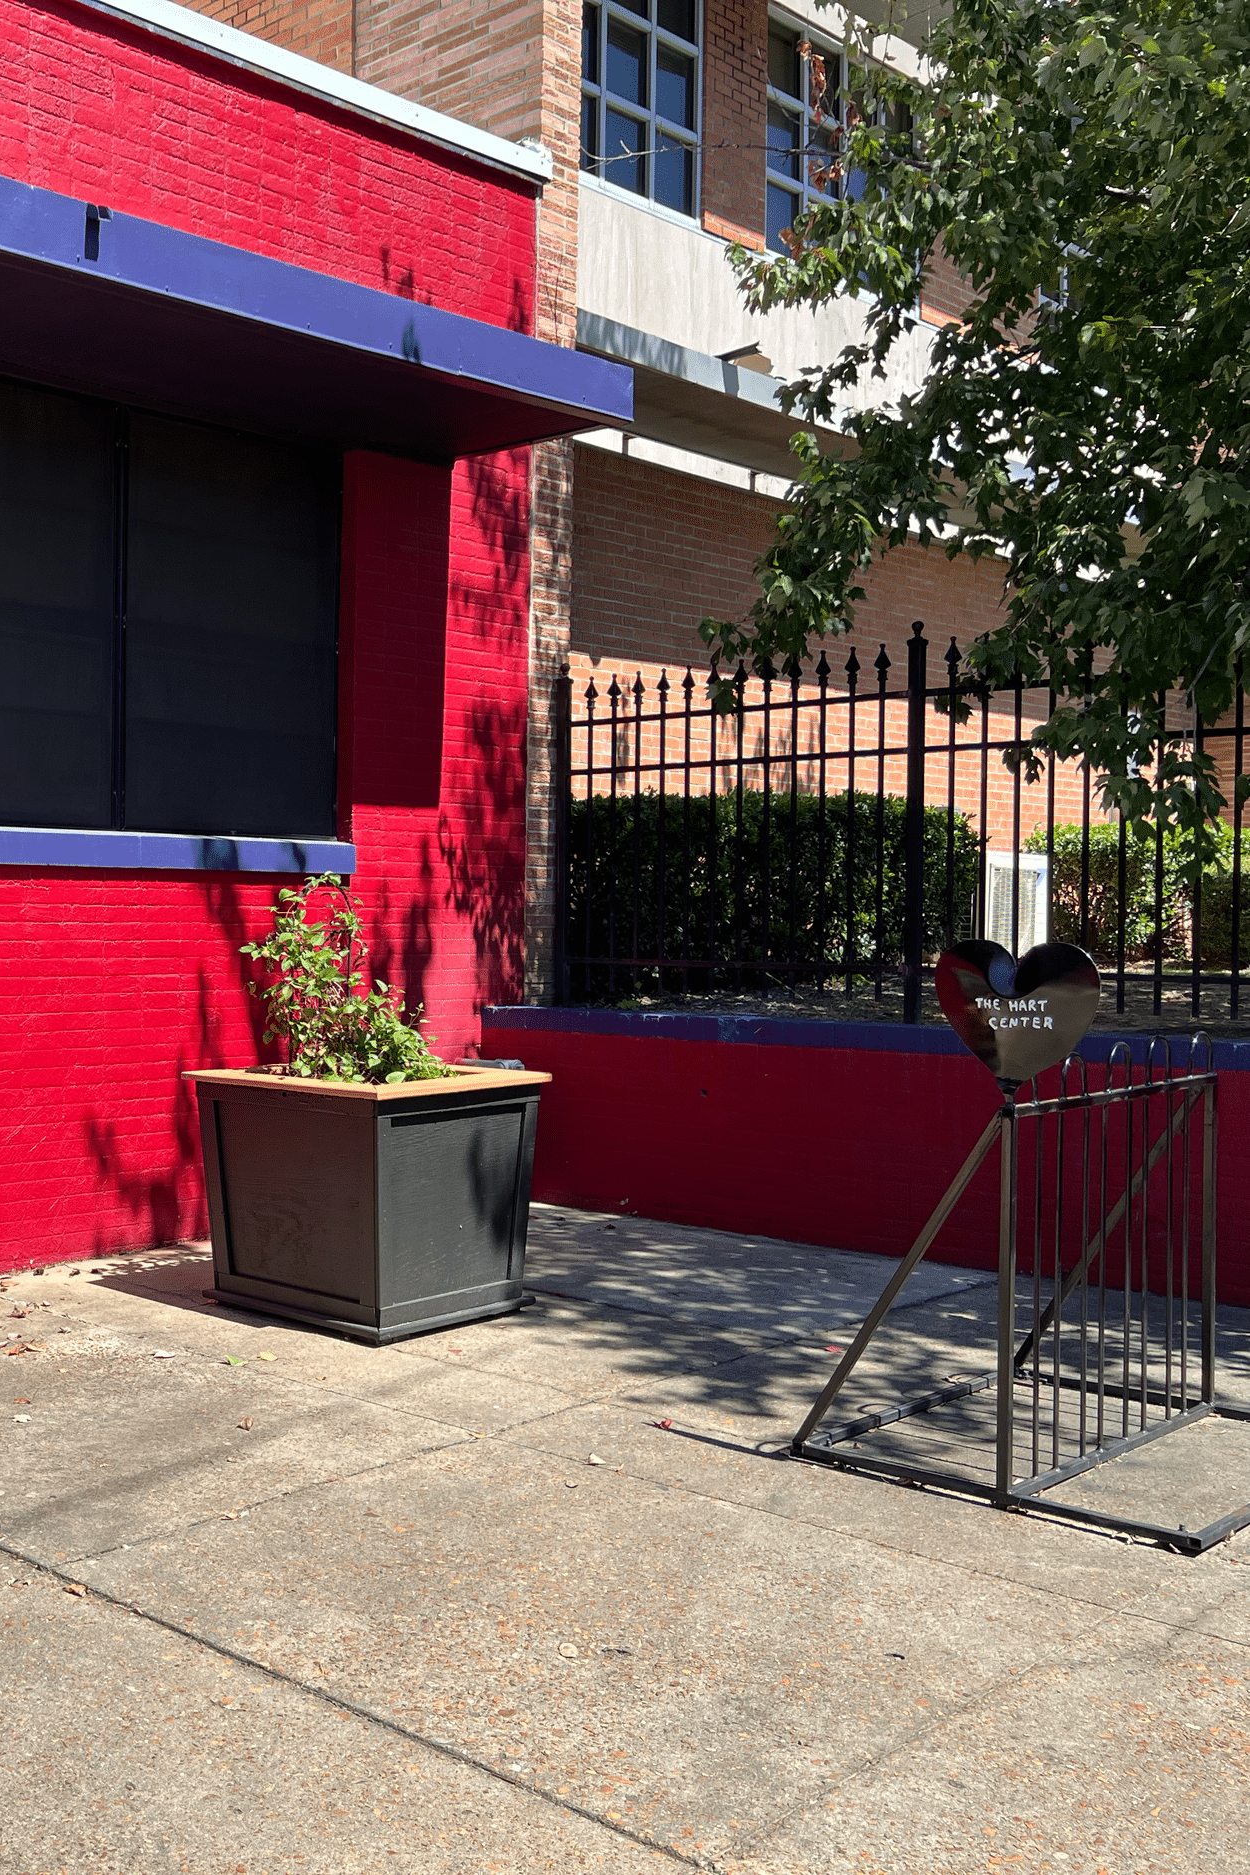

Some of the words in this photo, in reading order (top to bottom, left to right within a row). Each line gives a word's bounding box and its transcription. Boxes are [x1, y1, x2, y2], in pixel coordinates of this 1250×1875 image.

[975, 997, 1000, 1011] THE
[1008, 999, 1048, 1013] HART
[988, 1016, 1054, 1030] CENTER
